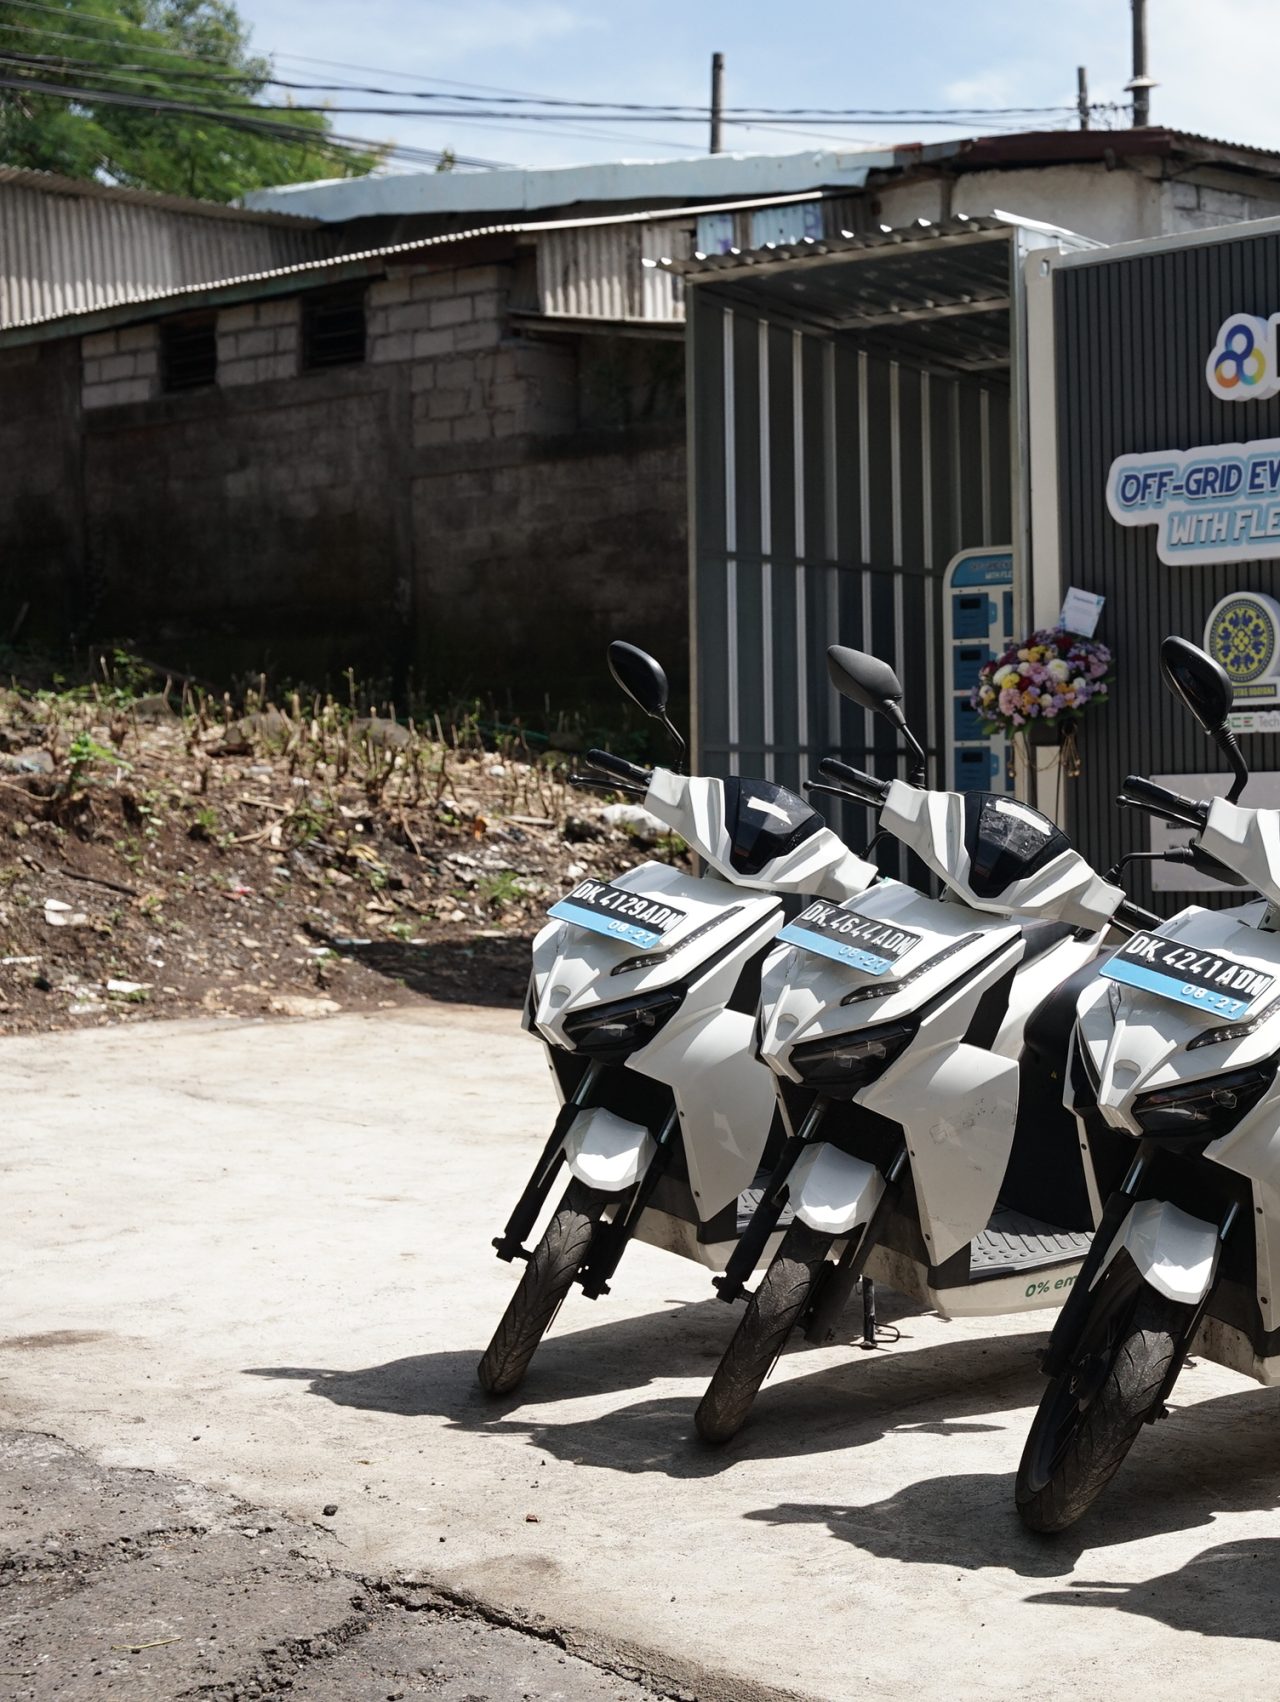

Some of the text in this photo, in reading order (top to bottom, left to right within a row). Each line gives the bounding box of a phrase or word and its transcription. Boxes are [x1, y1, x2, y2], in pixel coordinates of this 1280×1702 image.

[1120, 463, 1243, 505] OFF-GRID
[1169, 508, 1233, 547] WITH
[571, 882, 606, 905] DK
[600, 891, 649, 917] 4129
[801, 904, 917, 956] DK 4644 ADN
[1125, 935, 1272, 997] DK 4241 ADN
[1025, 1275, 1079, 1298] 0% em
